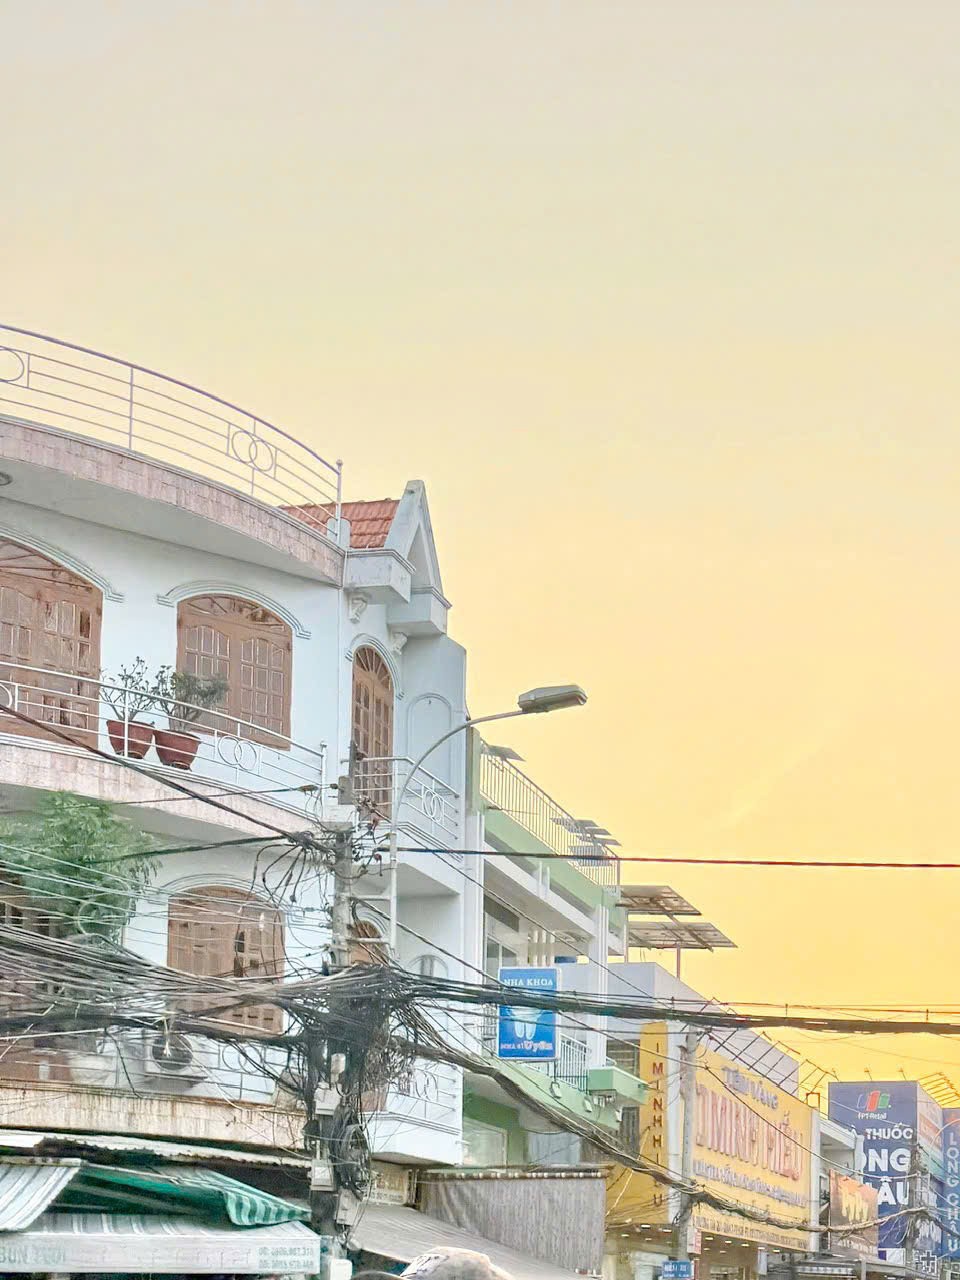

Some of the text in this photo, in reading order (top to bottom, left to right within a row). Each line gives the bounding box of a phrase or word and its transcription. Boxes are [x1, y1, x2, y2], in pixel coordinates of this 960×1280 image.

[527, 978, 553, 986] KHOA
[866, 1122, 913, 1140] THUỐC
[946, 1132, 960, 1188] LONG
